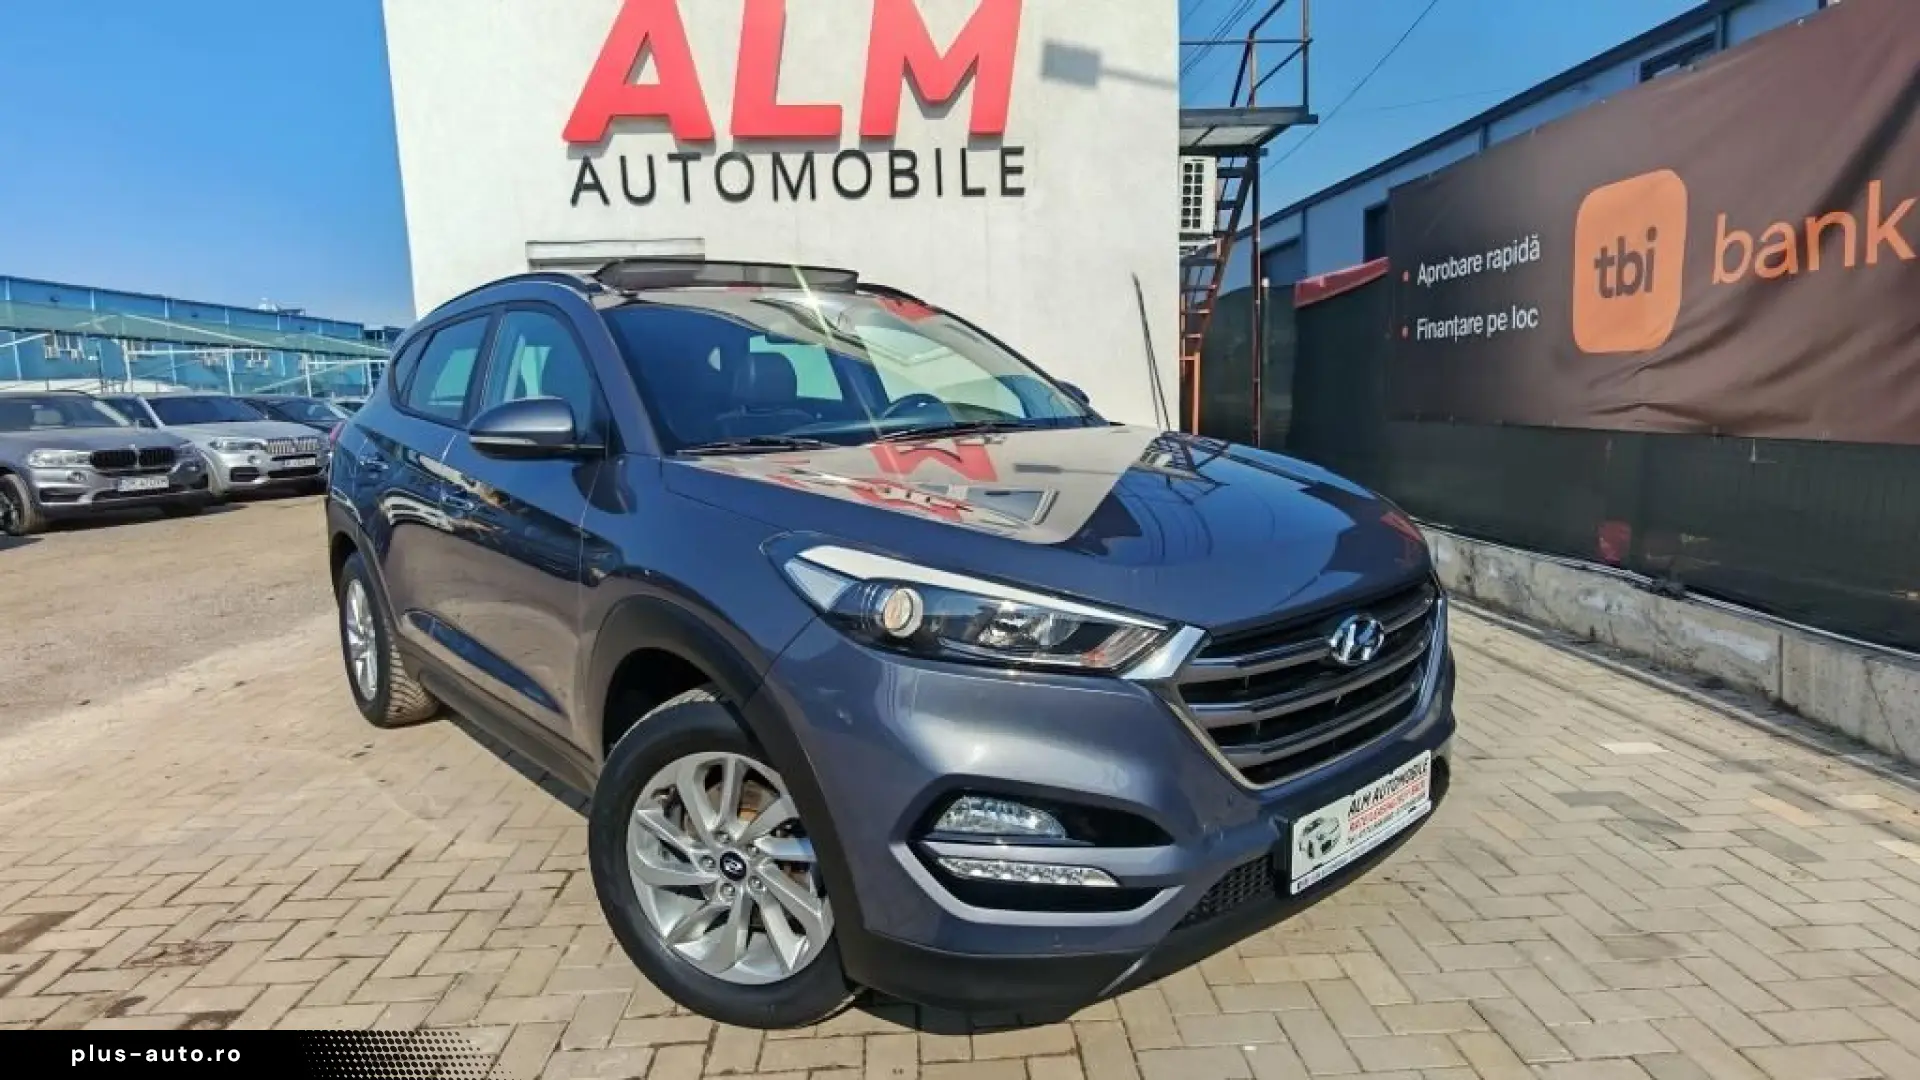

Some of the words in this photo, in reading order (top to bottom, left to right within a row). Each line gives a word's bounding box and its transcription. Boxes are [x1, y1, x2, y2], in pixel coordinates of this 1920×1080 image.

[562, 0, 1022, 142] ALM
[571, 147, 1025, 206] AUTOMOBILE
[1417, 255, 1482, 287] Aprobare
[1486, 233, 1541, 272] rapidă
[1711, 179, 1918, 285] bank
[1594, 226, 1658, 298] tbi
[1486, 313, 1508, 337] pe
[1512, 305, 1539, 329] loc
[1348, 788, 1373, 815] ALM
